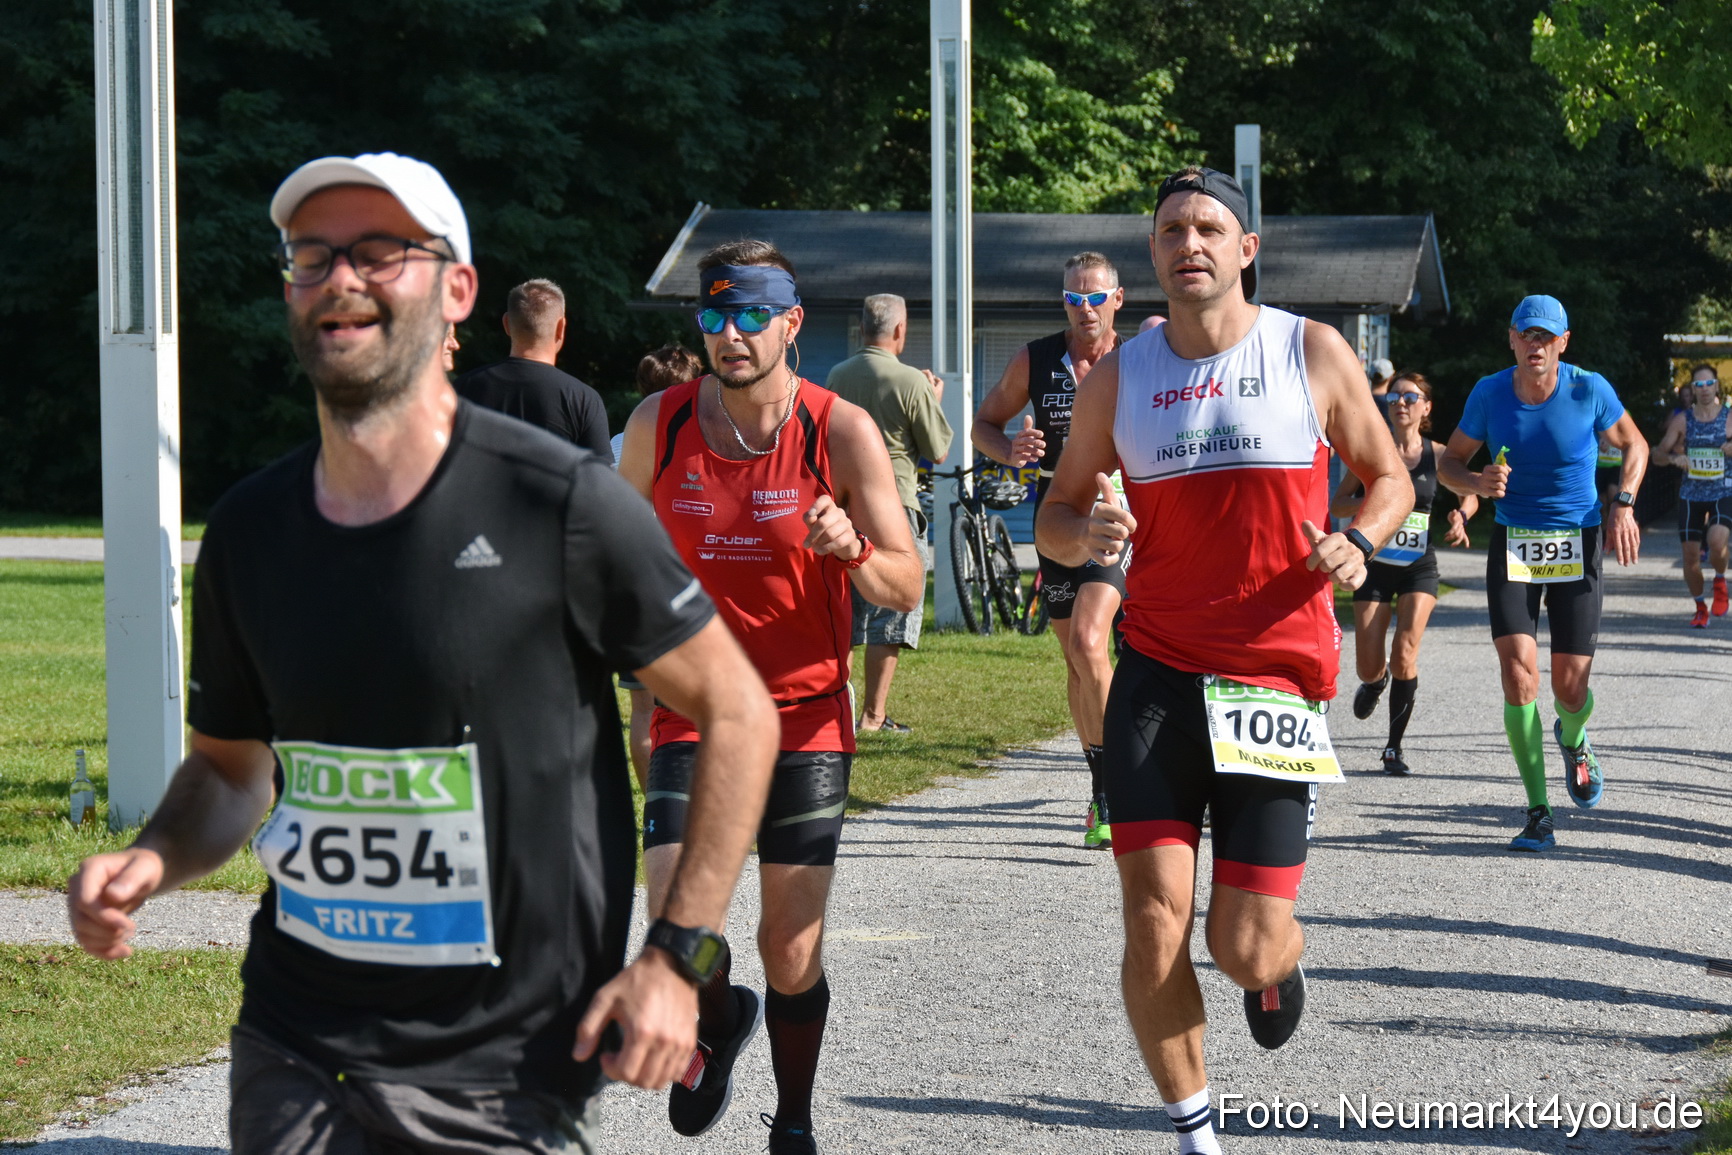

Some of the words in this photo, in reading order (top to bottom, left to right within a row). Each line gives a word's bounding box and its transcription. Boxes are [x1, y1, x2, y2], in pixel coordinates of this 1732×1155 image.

[1152, 377, 1225, 411] speck
[1175, 424, 1239, 442] HUCKAUF
[1155, 437, 1263, 462] INGENIEURE
[1692, 459, 1720, 469] 1153
[752, 489, 799, 500] HEINLOTH
[704, 534, 763, 545] Gruber
[1516, 541, 1574, 562] 1393
[454, 553, 503, 569] adidas
[1224, 709, 1317, 752] 1084
[1237, 748, 1316, 773] MARKUS
[292, 751, 457, 807] BOCK
[277, 821, 455, 888] 2654
[313, 904, 417, 939] FRITZ
